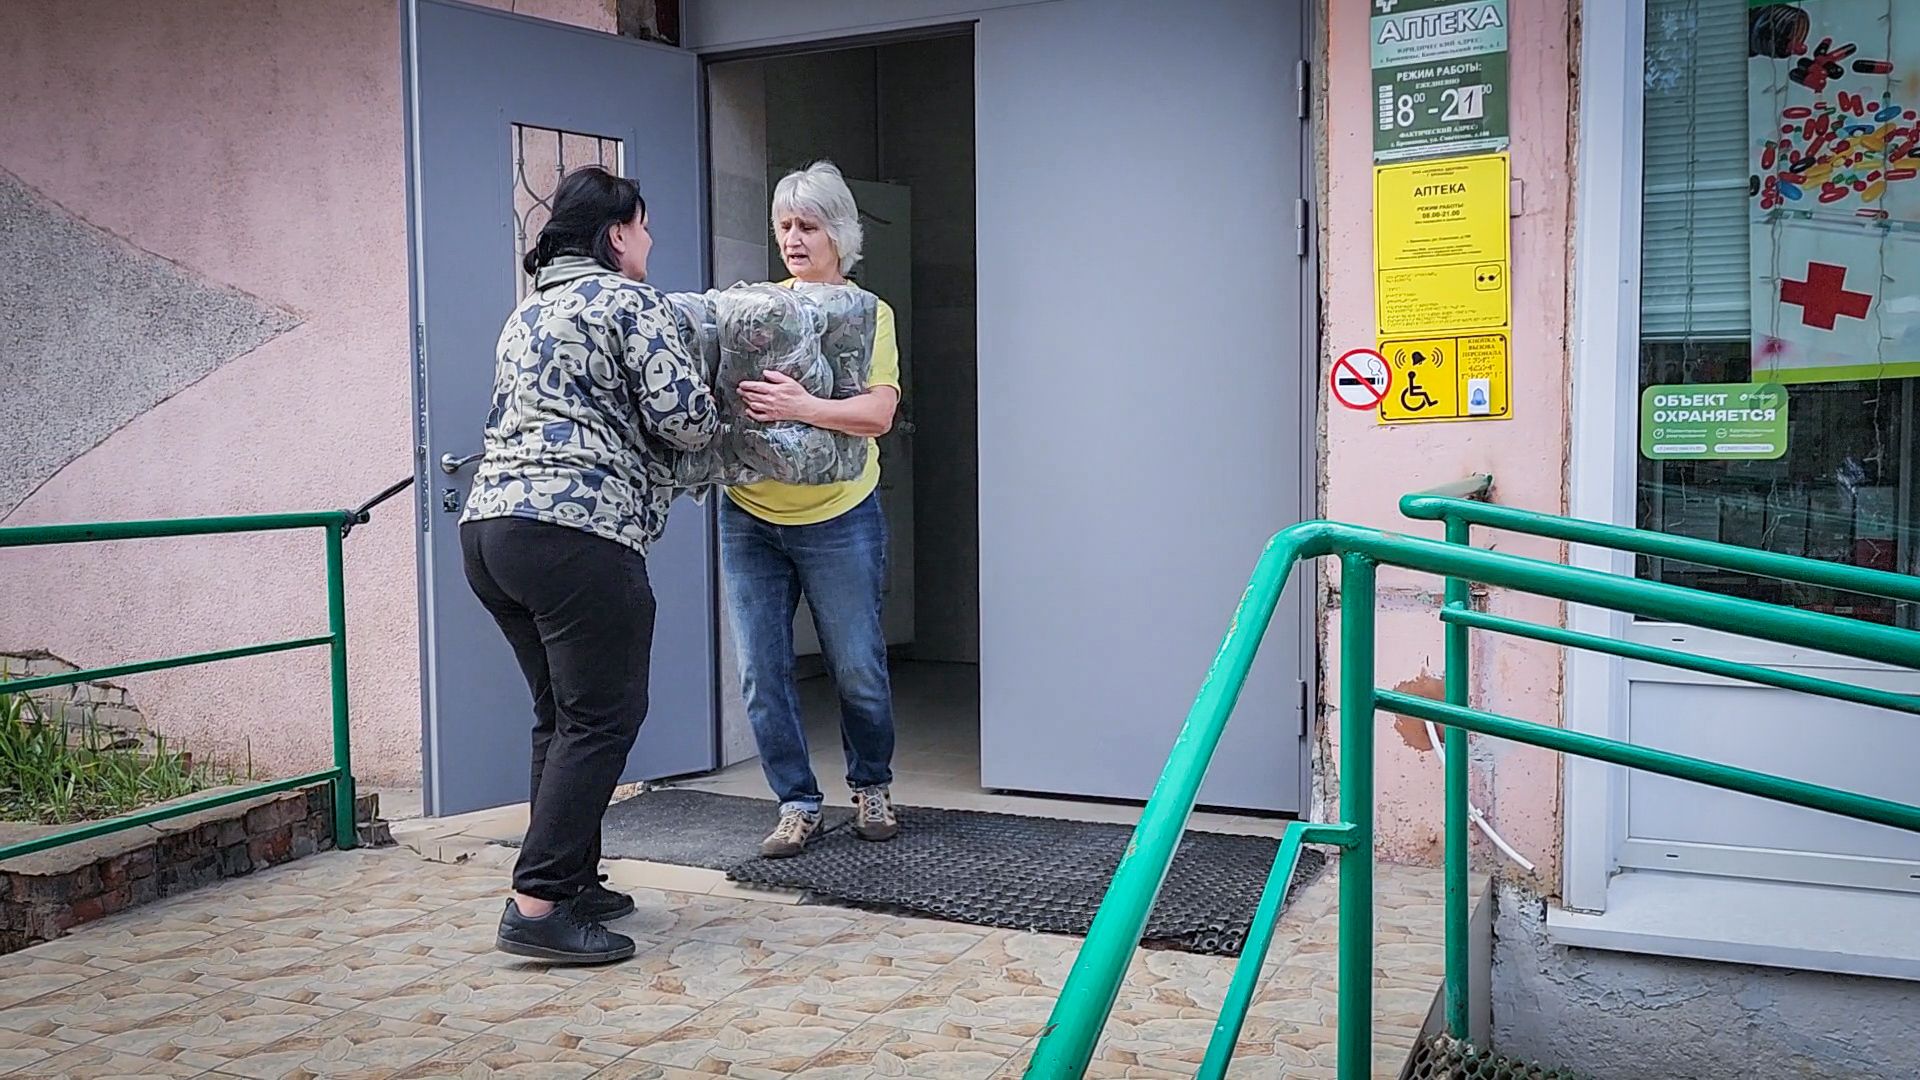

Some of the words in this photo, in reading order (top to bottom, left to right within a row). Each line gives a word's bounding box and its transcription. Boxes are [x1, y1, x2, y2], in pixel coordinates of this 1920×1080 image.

[1377, 5, 1503, 45] АПТЕКА
[1396, 68, 1435, 82] РЕЖИМ
[1436, 62, 1482, 77] РАБОТЫ:
[1413, 183, 1466, 197] АПТЕКА
[1653, 393, 1728, 407] ОБЪЕКТ
[1653, 408, 1776, 423] ОХРАНЯЕТСЯ
